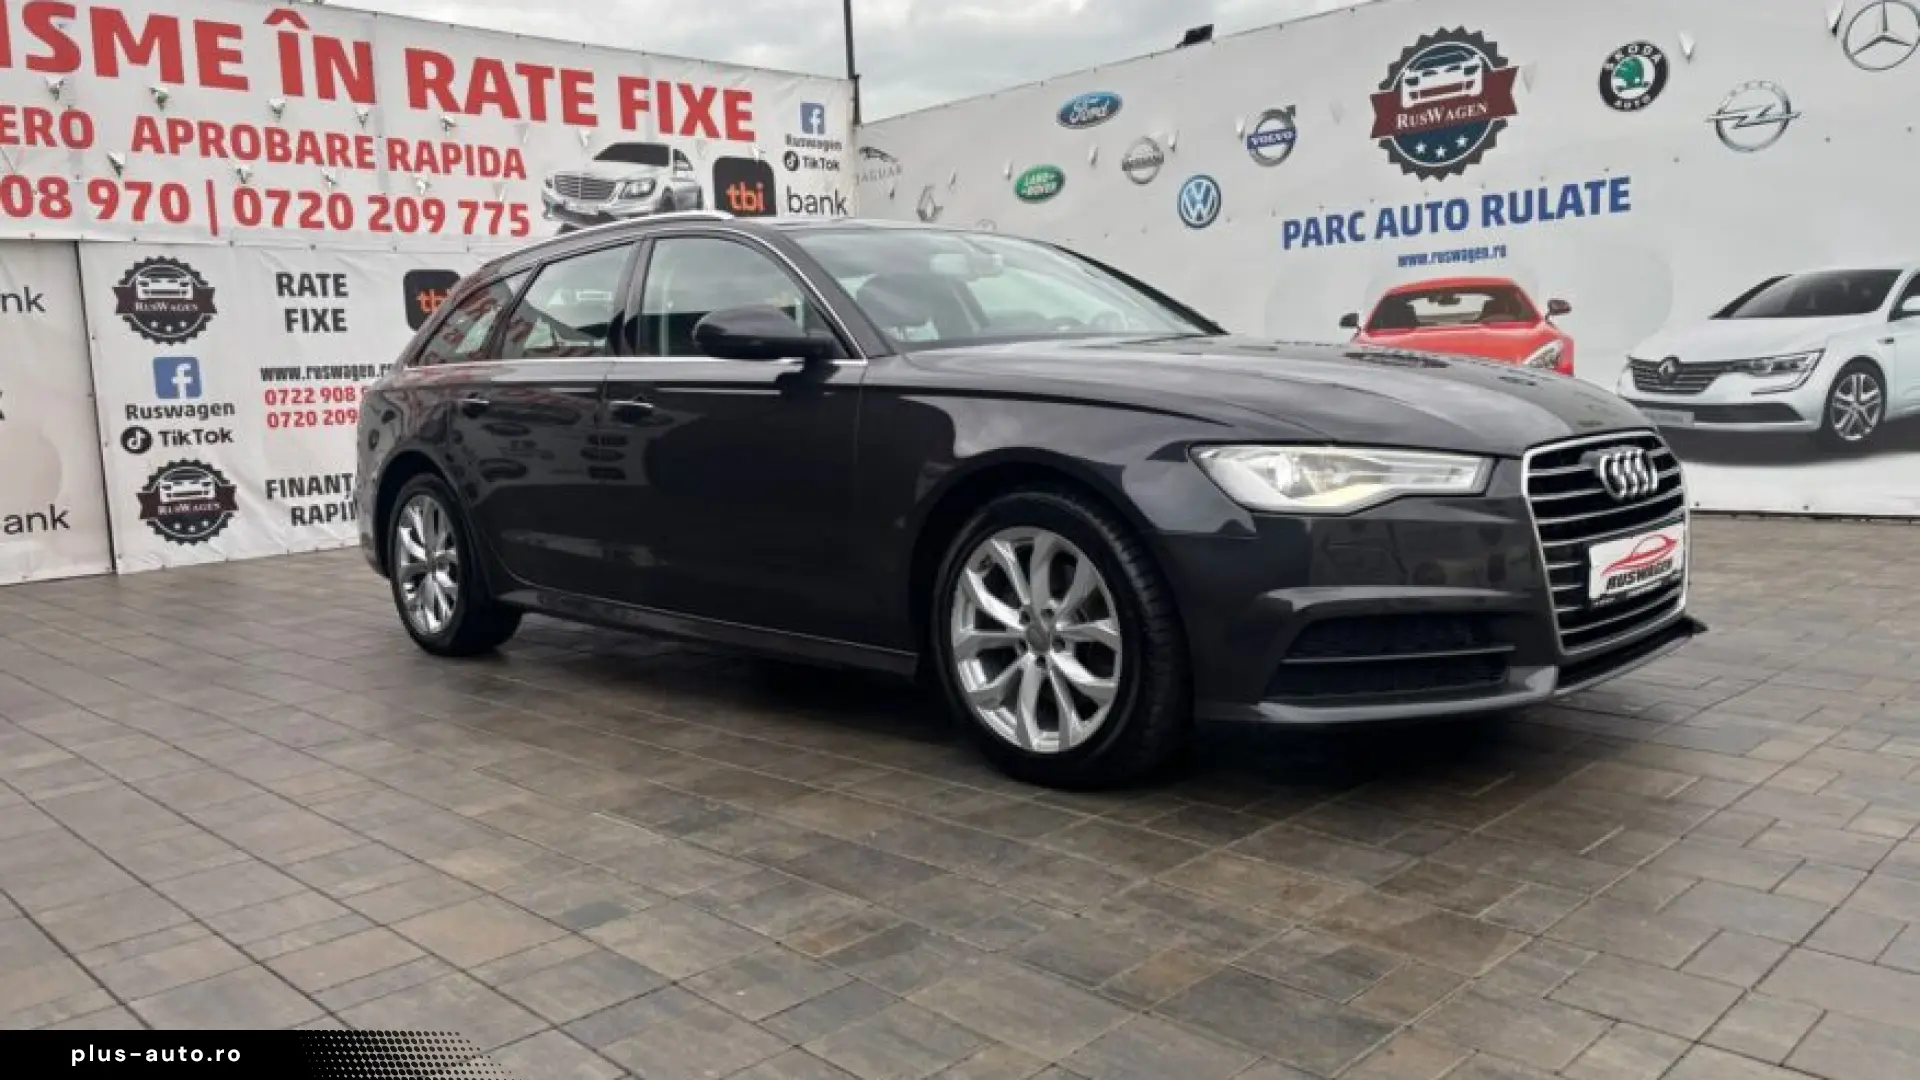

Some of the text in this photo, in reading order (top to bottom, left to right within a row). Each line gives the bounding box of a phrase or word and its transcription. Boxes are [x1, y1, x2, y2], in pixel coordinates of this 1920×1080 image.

[263, 8, 376, 105] ÎN
[404, 47, 598, 127] RATE
[618, 76, 755, 142] FIXE
[0, 105, 527, 180] ERO APROBARE RAPIDA
[1250, 131, 1293, 147] VOLVO
[802, 156, 840, 171] TikTok
[0, 174, 73, 219] 08
[87, 178, 190, 223] 970
[233, 187, 354, 231] 0720
[368, 193, 446, 233] 209
[458, 199, 530, 237] 775
[727, 182, 765, 213] tbi
[787, 185, 847, 215] bank
[1282, 176, 1632, 250] PARC AUTO RULATE
[1398, 244, 1506, 267] www.ruswagen.ro
[275, 271, 350, 299] RATE
[416, 288, 447, 314] tb
[284, 308, 348, 334] FIXE
[264, 387, 316, 406] 0722
[320, 385, 356, 404] 908
[125, 403, 236, 420] Ruswagen
[267, 408, 358, 428] 0720 209
[158, 427, 235, 447] TikTok
